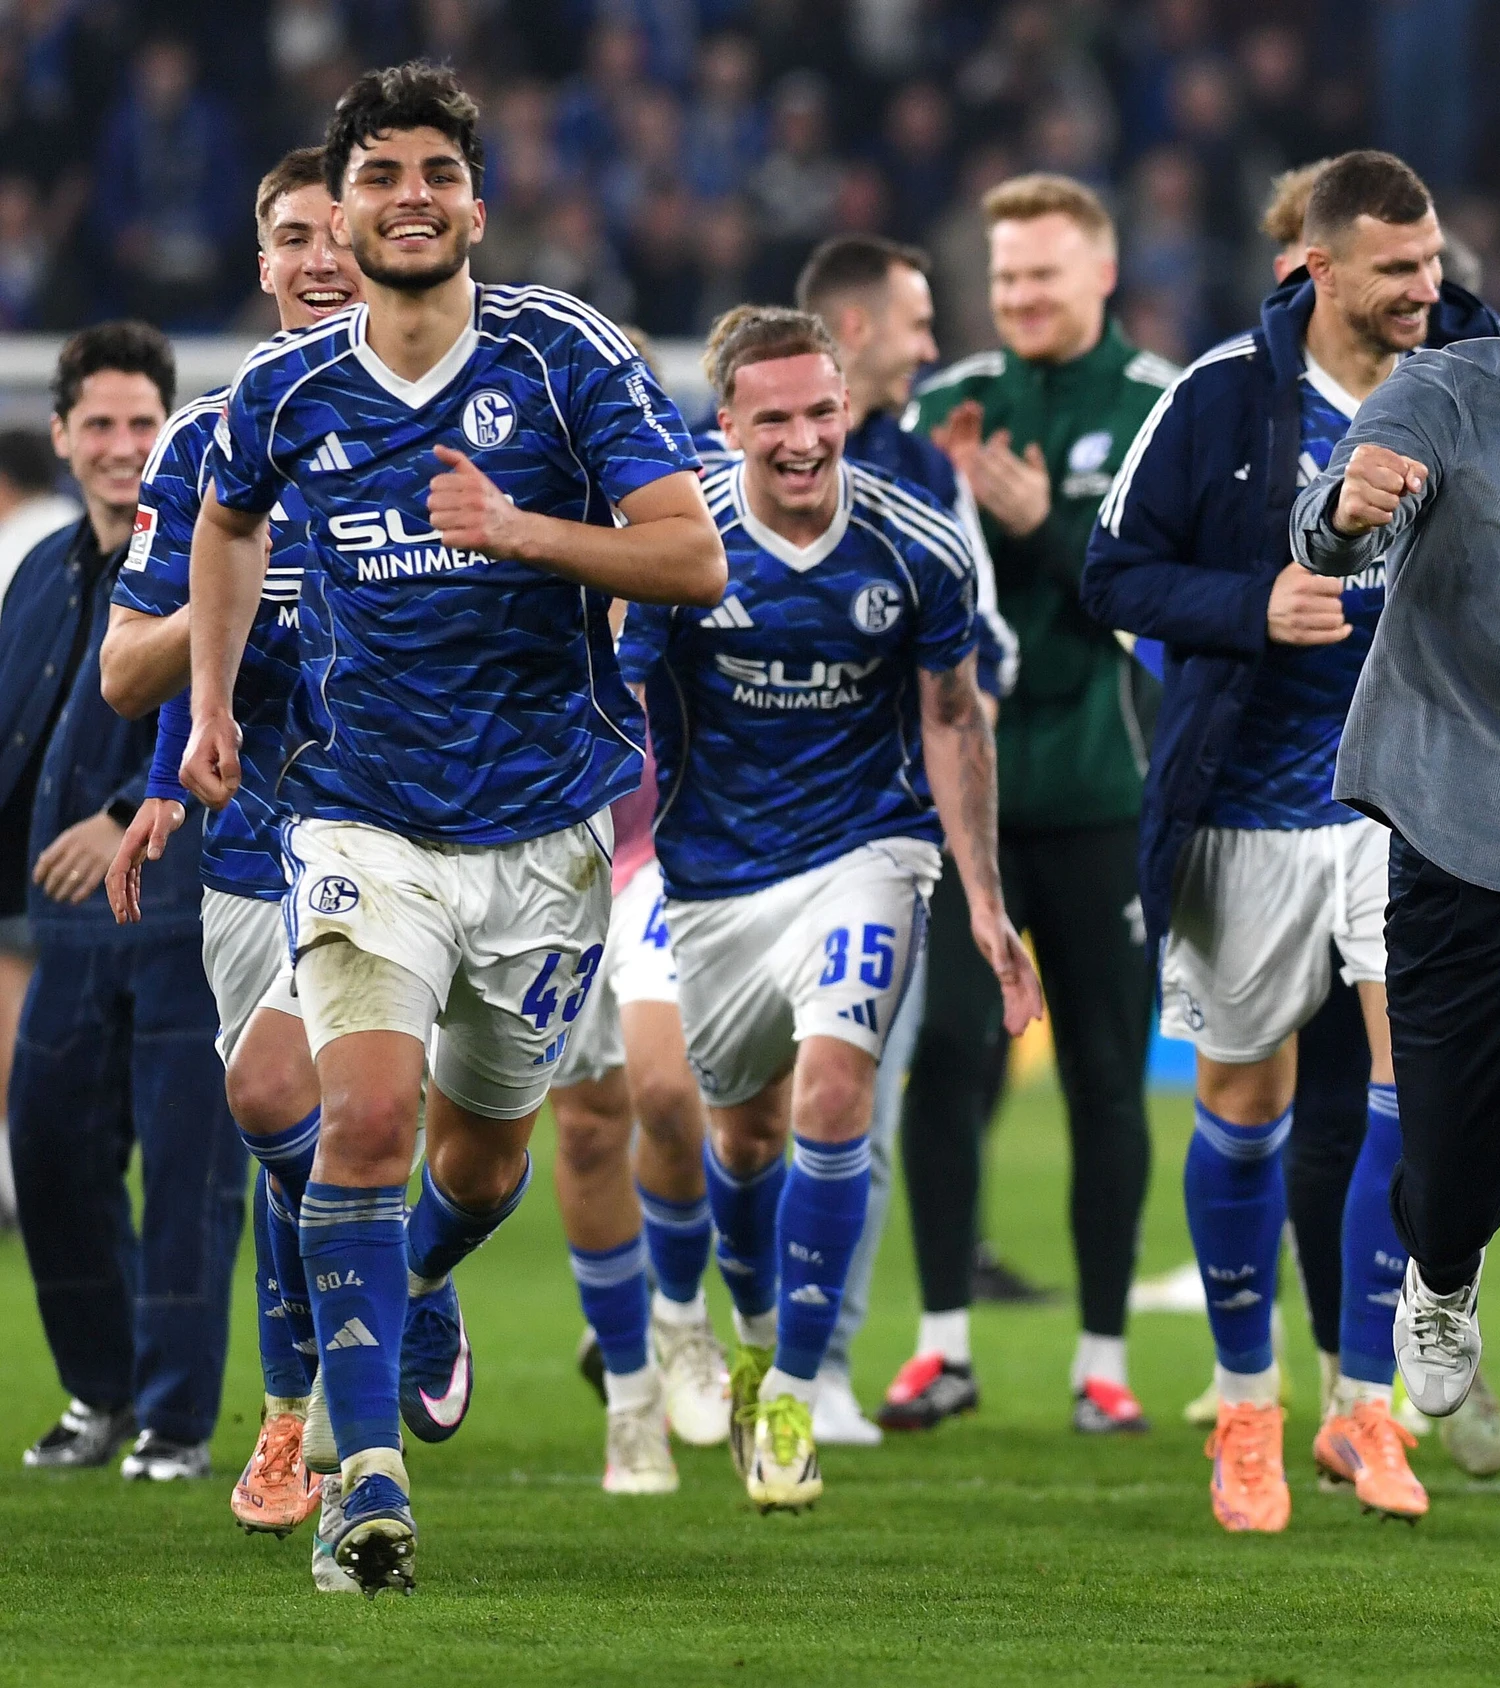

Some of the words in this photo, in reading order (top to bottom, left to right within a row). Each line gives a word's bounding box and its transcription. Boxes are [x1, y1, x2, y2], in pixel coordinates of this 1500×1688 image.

[357, 547, 499, 581] MINIMEA
[715, 653, 882, 689] SUN
[733, 683, 863, 709] MINIMEAL
[819, 923, 896, 990] 35
[520, 943, 604, 1029] 43
